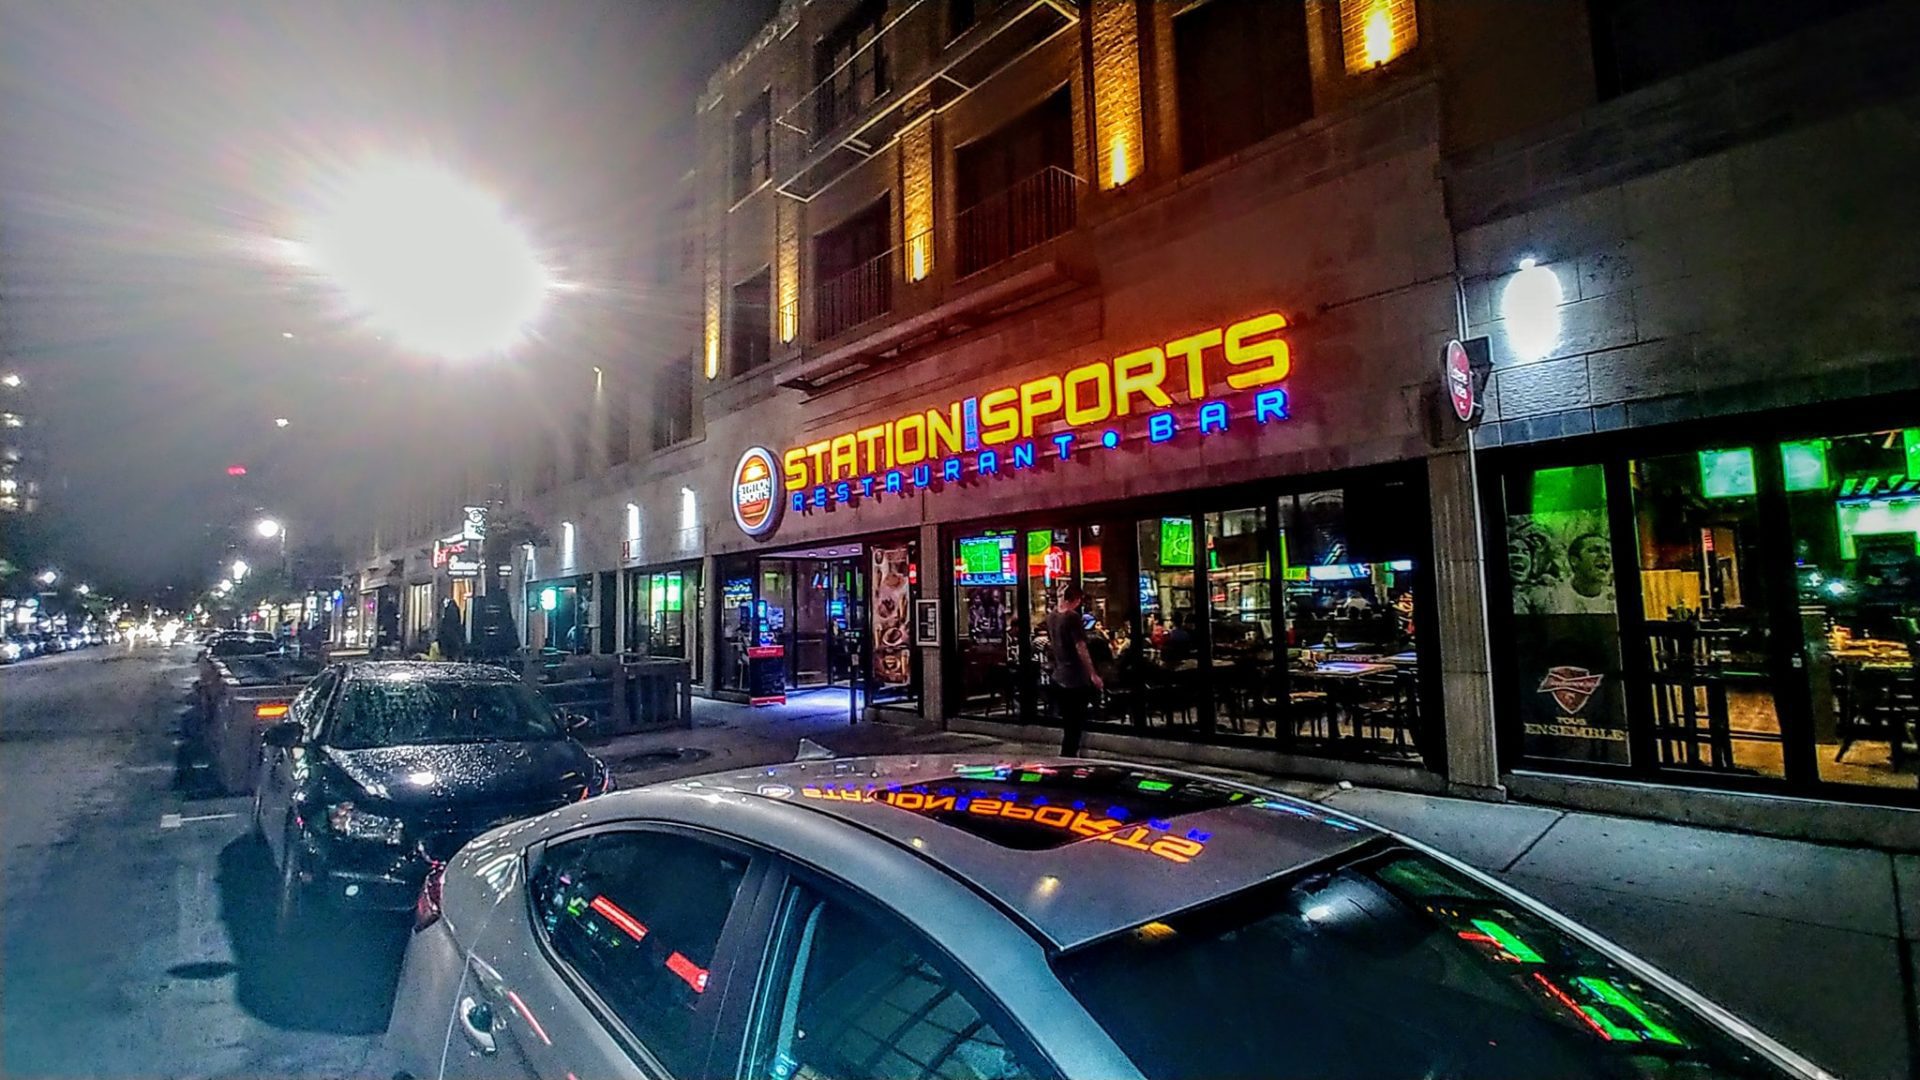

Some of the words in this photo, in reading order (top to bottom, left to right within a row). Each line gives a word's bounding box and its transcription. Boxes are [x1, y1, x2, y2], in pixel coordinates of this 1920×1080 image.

[784, 401, 962, 491] STATION
[981, 313, 1290, 446] SPORTS
[792, 434, 1074, 511] RESTAURANT
[1150, 388, 1288, 443] BAR
[1524, 723, 1627, 741] ENSEMBLE
